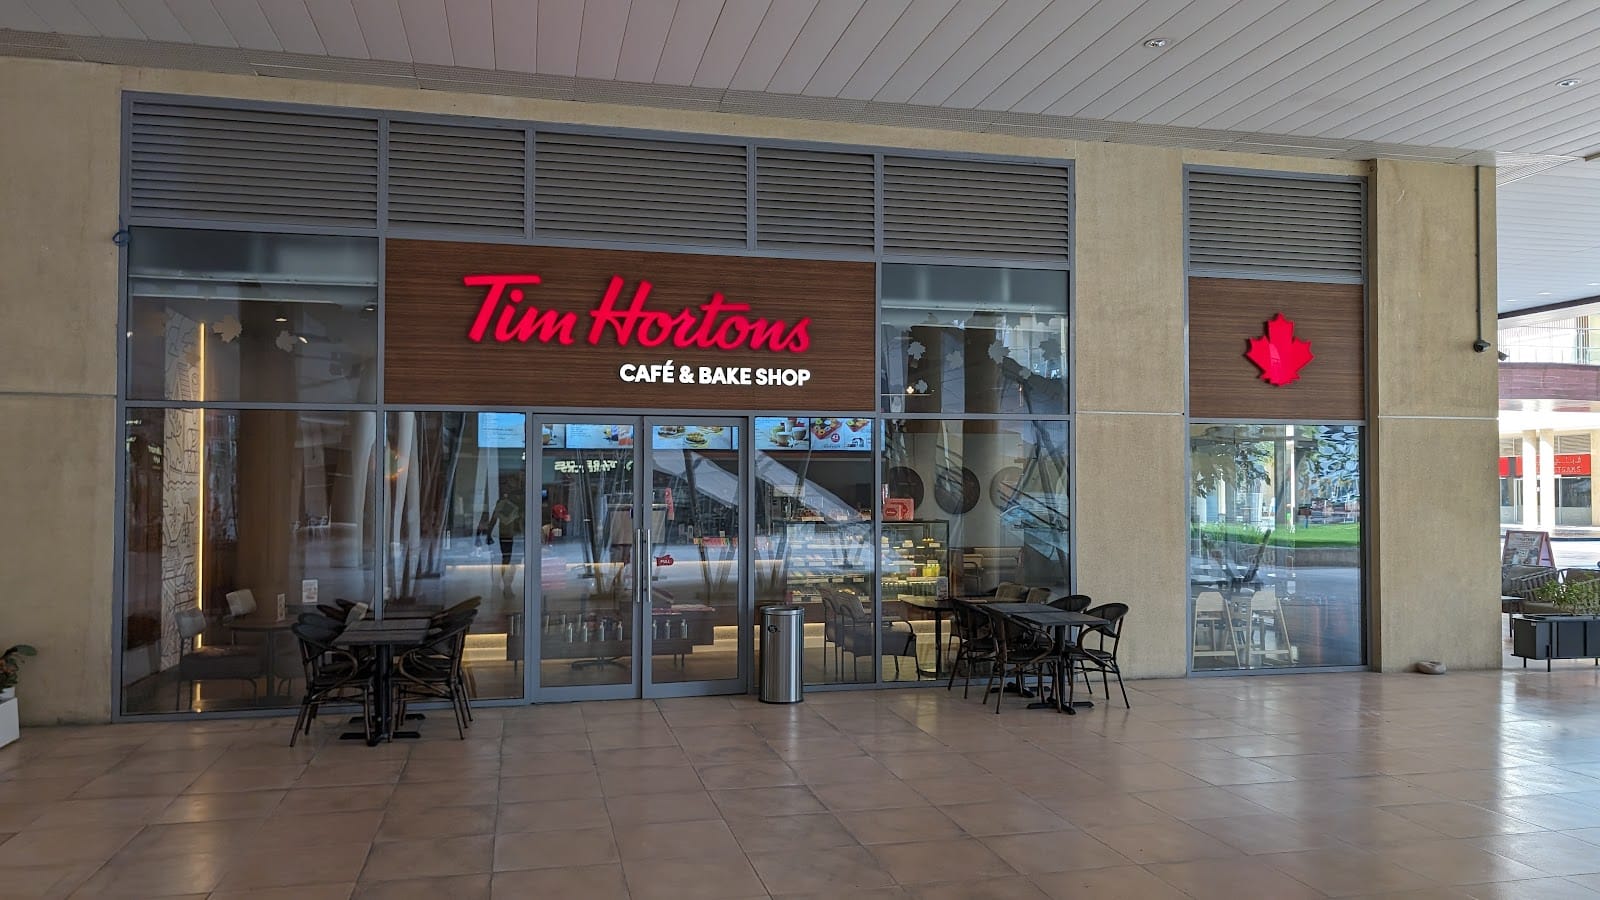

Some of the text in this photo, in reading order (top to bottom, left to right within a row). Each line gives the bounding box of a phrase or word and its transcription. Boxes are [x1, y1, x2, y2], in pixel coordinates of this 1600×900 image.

[463, 274, 811, 354] Tim Hortons
[619, 359, 812, 387] CAFÉ & BAKE SHOP
